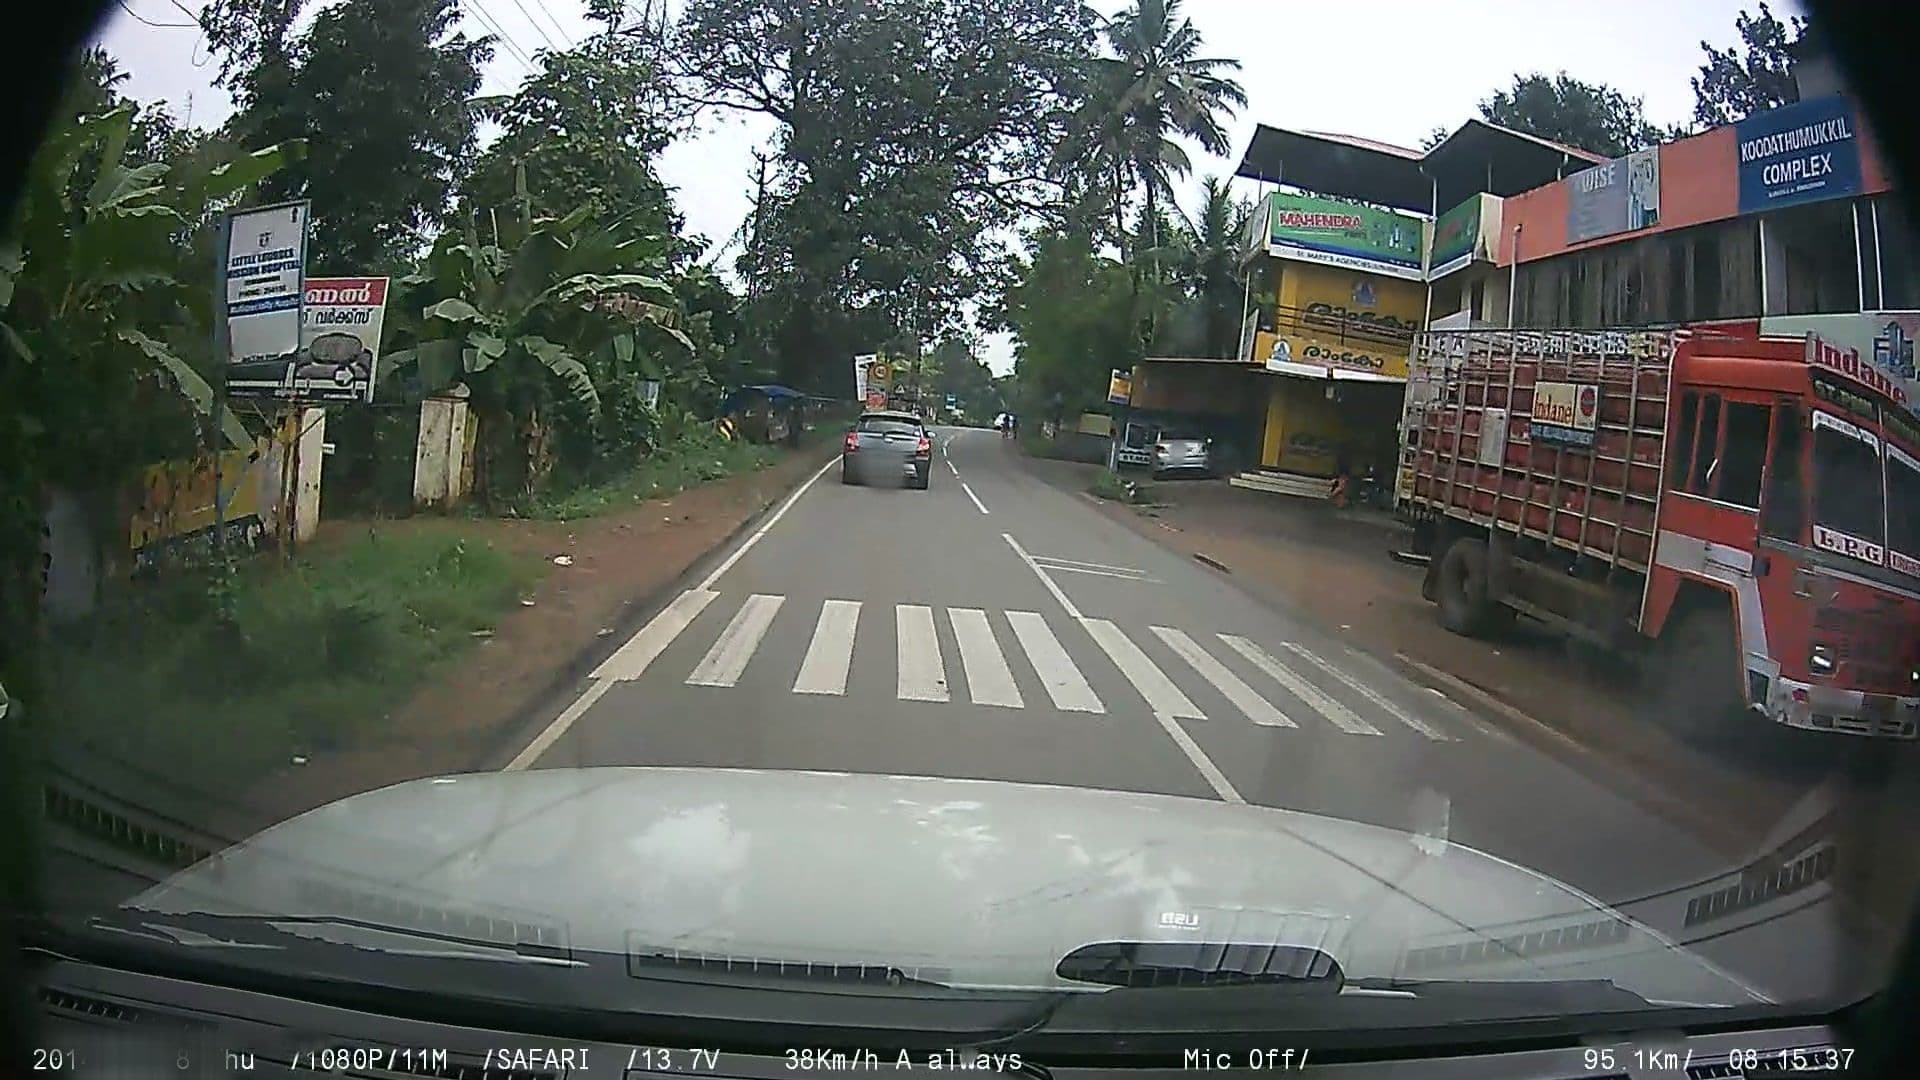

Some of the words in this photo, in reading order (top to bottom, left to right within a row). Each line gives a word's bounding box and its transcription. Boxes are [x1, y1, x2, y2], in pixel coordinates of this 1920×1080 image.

[1741, 117, 1852, 162] KOODATHUMUKKIL
[1763, 152, 1832, 185] COMPLEX
[1279, 211, 1361, 228] MAHENDRA
[1815, 336, 1907, 404] Indane
[1534, 391, 1573, 423] Indane
